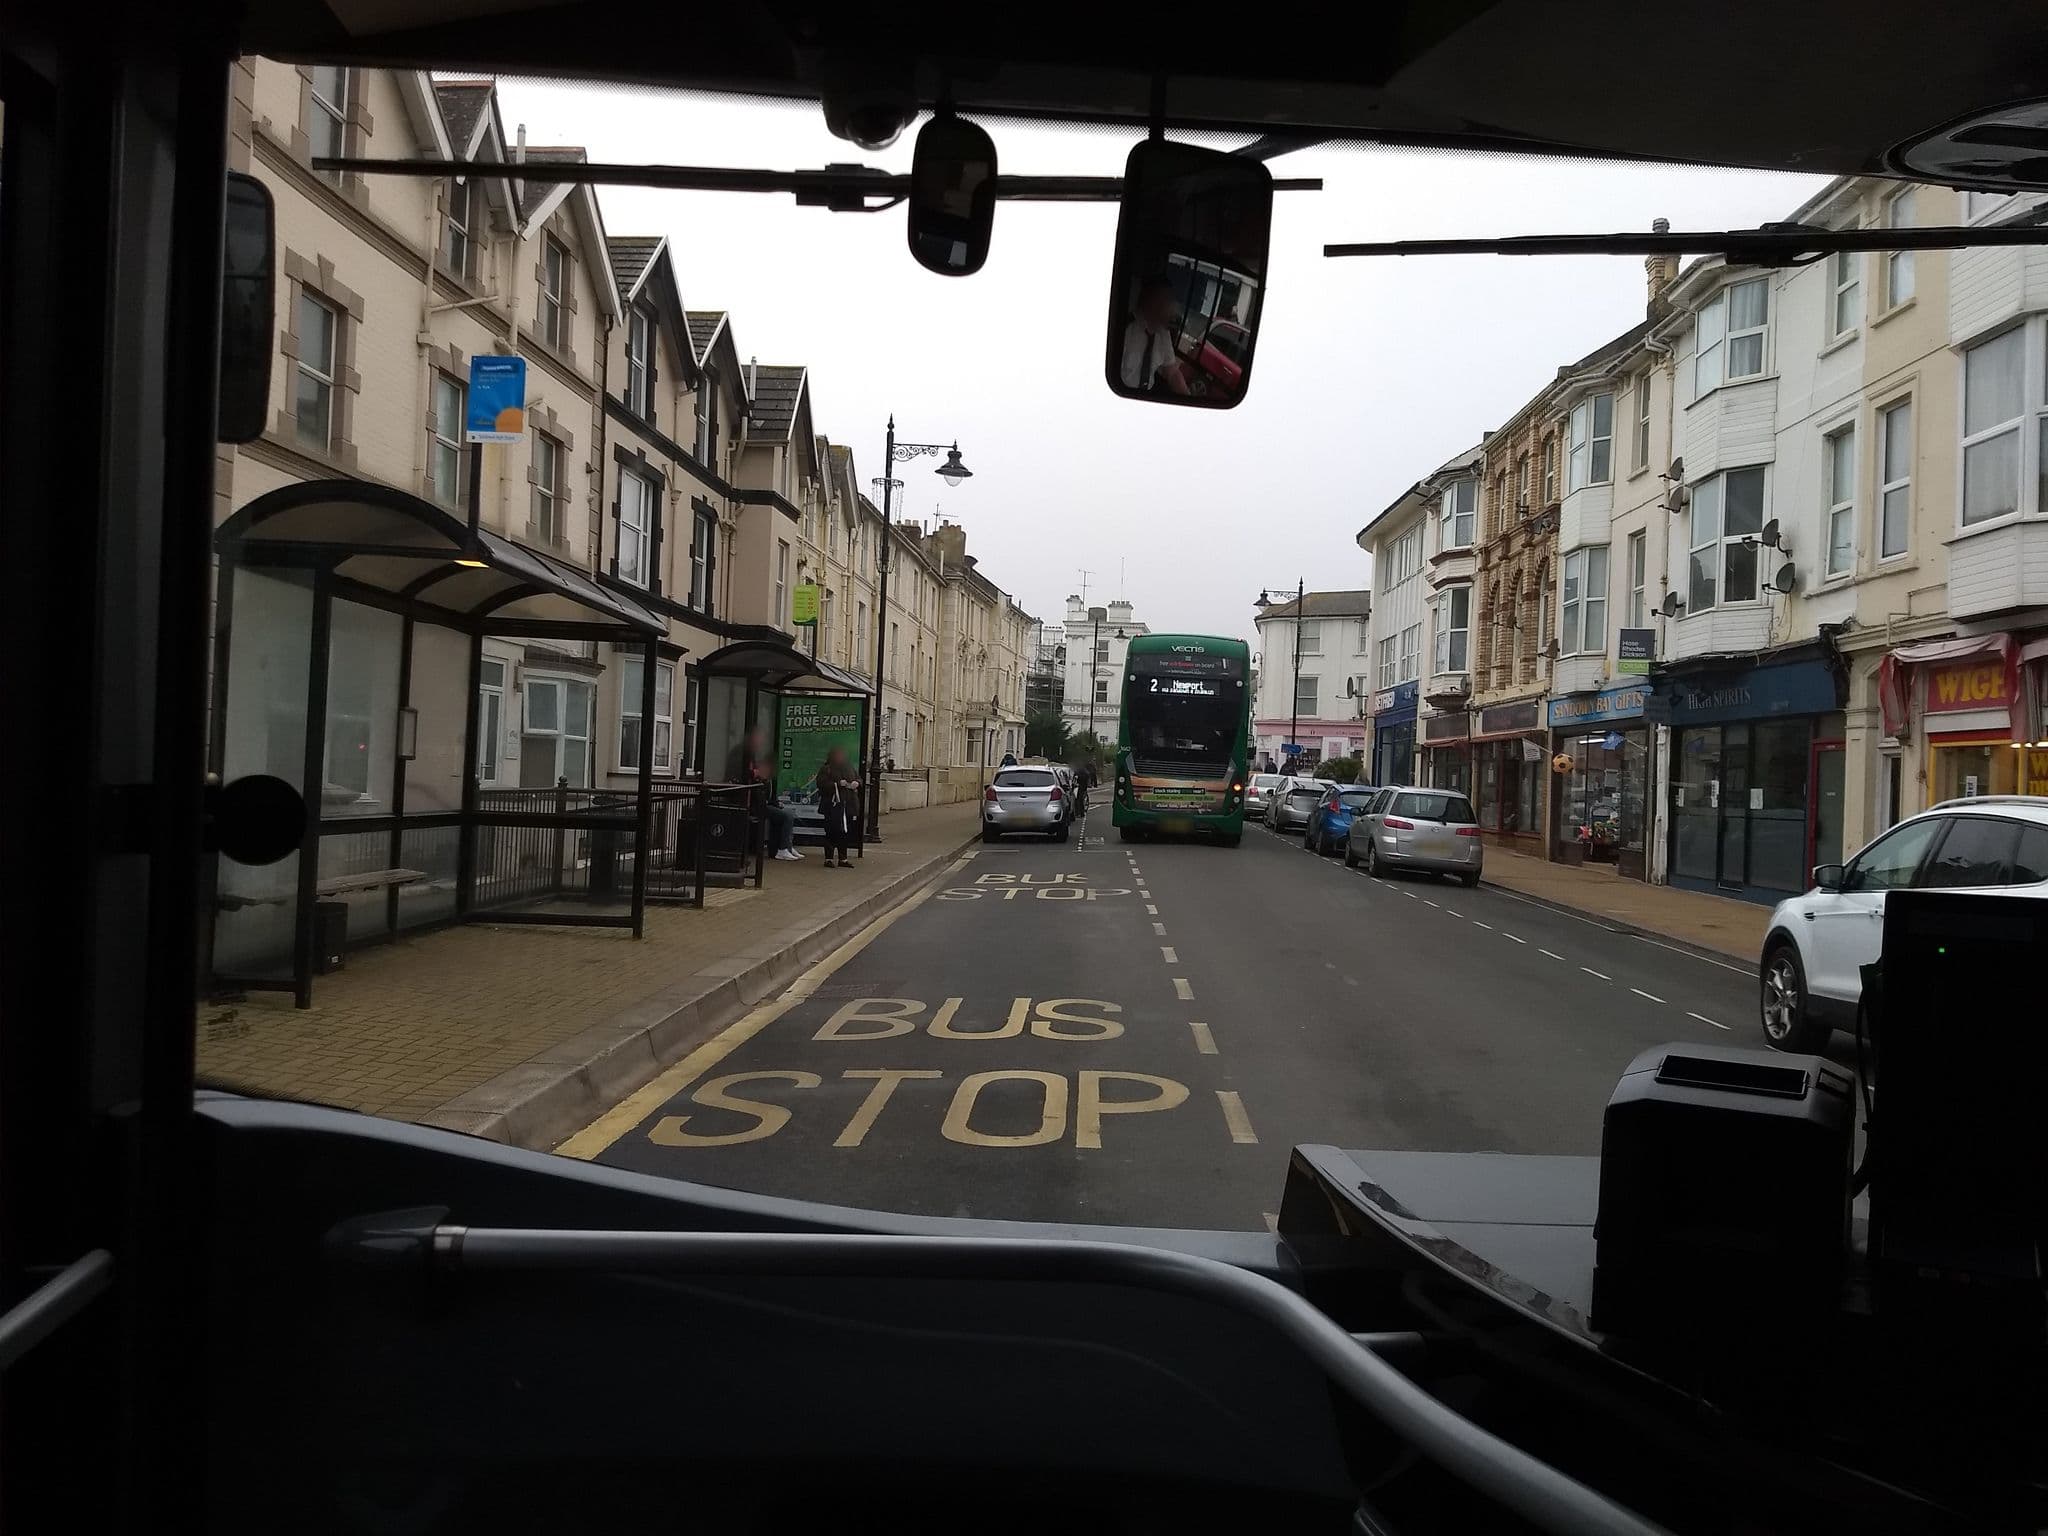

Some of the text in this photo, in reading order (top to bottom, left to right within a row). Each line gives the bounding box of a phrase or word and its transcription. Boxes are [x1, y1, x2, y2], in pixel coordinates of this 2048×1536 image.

[1171, 645, 1205, 653] VECTIS
[1150, 679, 1158, 692] 2
[1173, 679, 1204, 690] Newport
[1596, 696, 1612, 713] BAY
[1616, 691, 1643, 710] GIFTS
[1713, 687, 1751, 706] SPIRITS
[786, 704, 818, 716] FREE
[786, 714, 857, 727] TONE ZONE
[974, 873, 1088, 885] BUS
[936, 887, 1132, 901] STOP
[812, 997, 1125, 1041] BUS
[647, 1068, 1191, 1149] STOP
